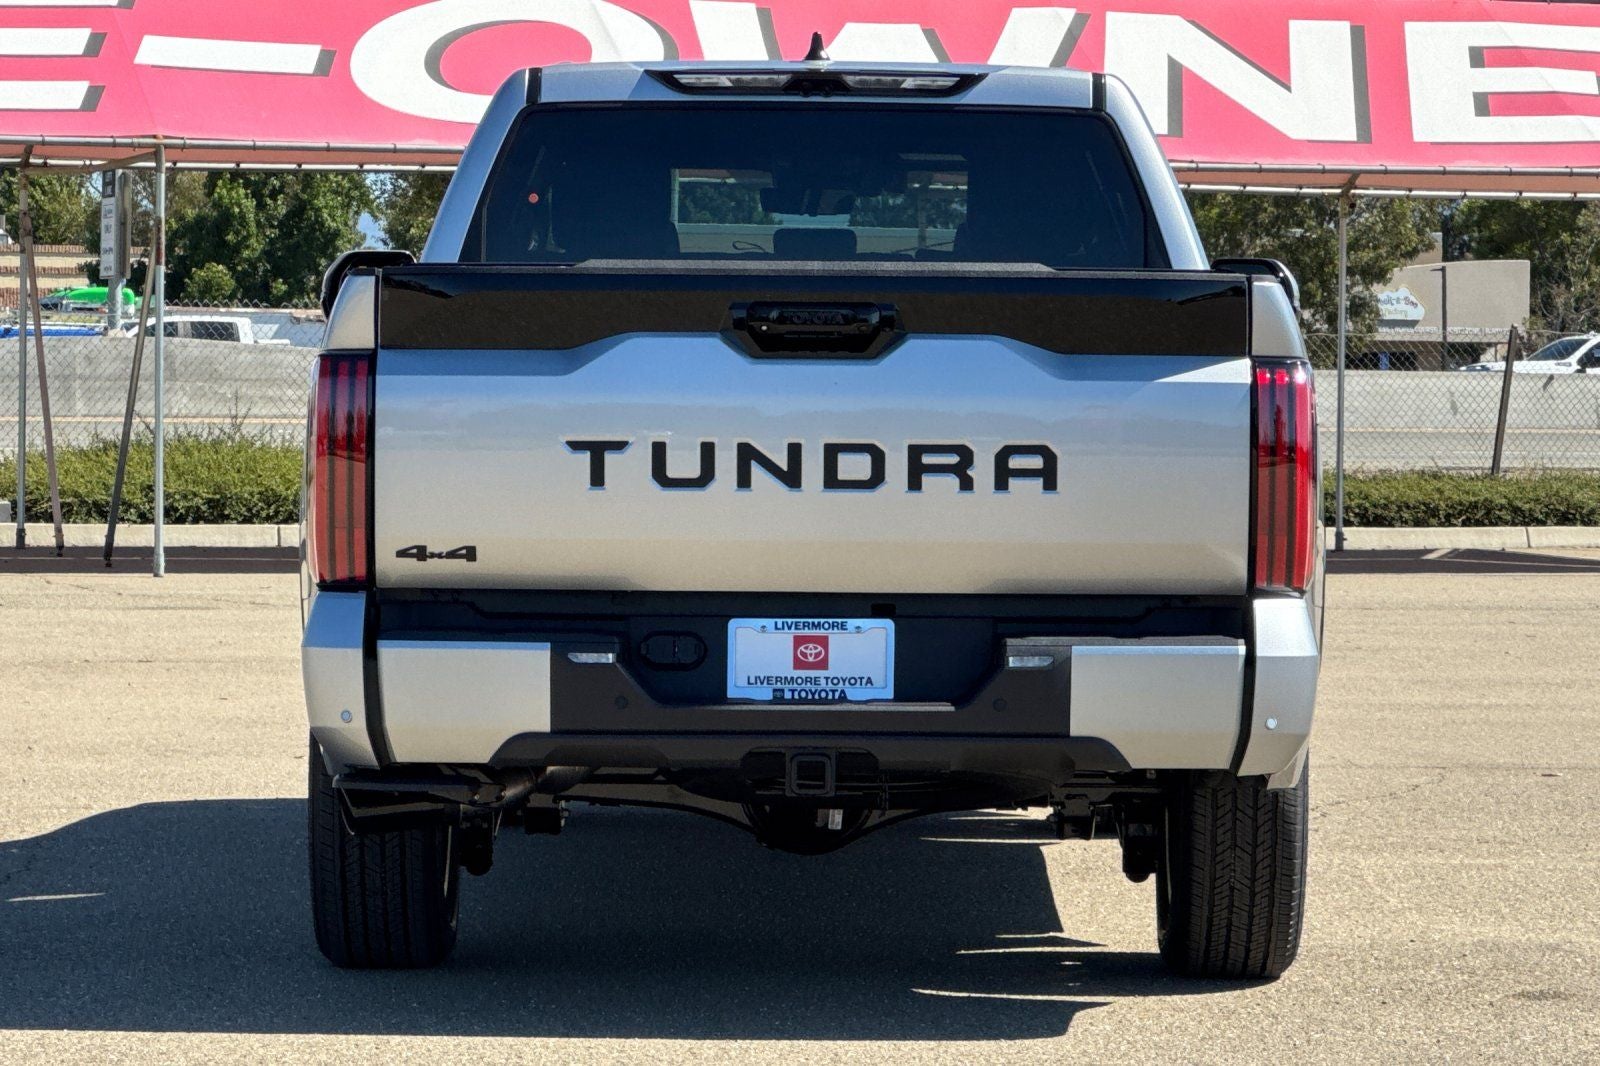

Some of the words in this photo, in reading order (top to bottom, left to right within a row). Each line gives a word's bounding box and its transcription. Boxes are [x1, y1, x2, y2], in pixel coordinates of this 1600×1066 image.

[783, 311, 845, 324] TOYOTA
[564, 440, 1059, 493] TUNDRA
[395, 544, 477, 562] 4x4
[774, 620, 849, 632] LIVERMORE
[747, 675, 822, 687] LIVERMORE
[824, 676, 874, 687] TOYOTA
[788, 688, 849, 700] TOYOTA
